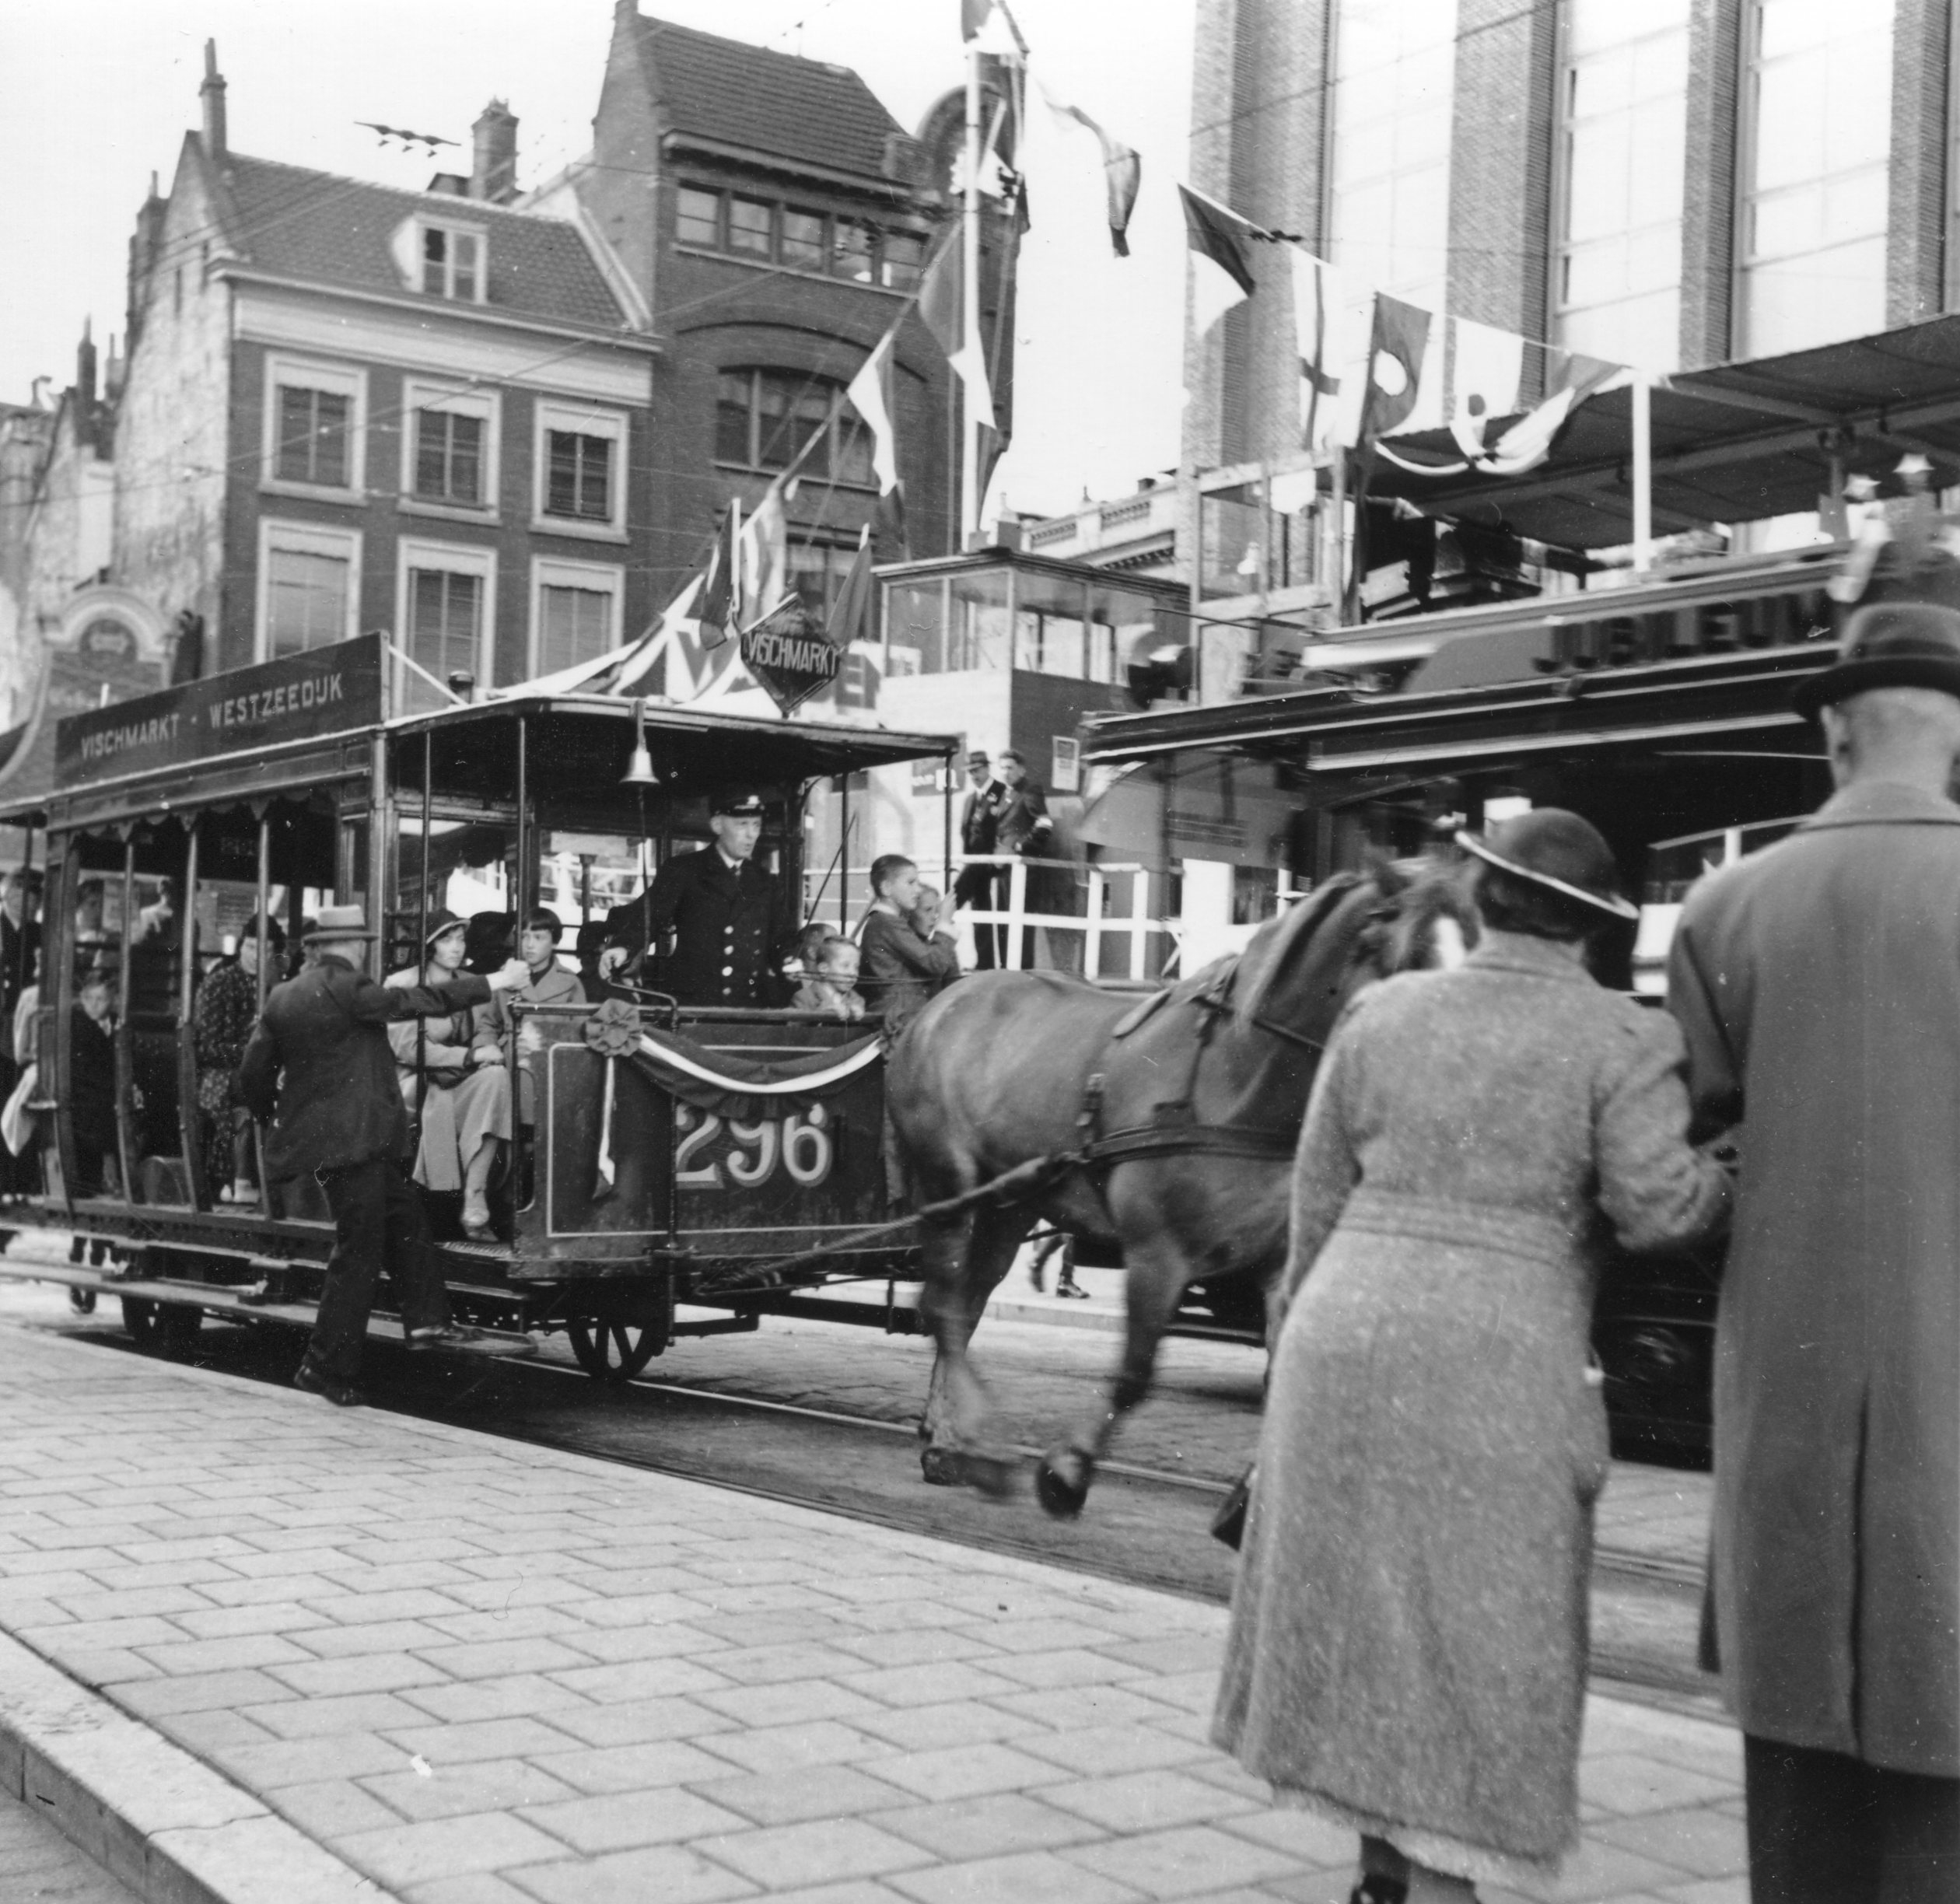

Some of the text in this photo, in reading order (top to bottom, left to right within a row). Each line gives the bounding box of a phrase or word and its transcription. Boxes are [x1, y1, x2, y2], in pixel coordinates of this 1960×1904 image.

[745, 631, 838, 677] VISCHMARKT
[81, 672, 343, 759] VISCHMARKT WESTZEEDIJK
[674, 1102, 833, 1189] 296
